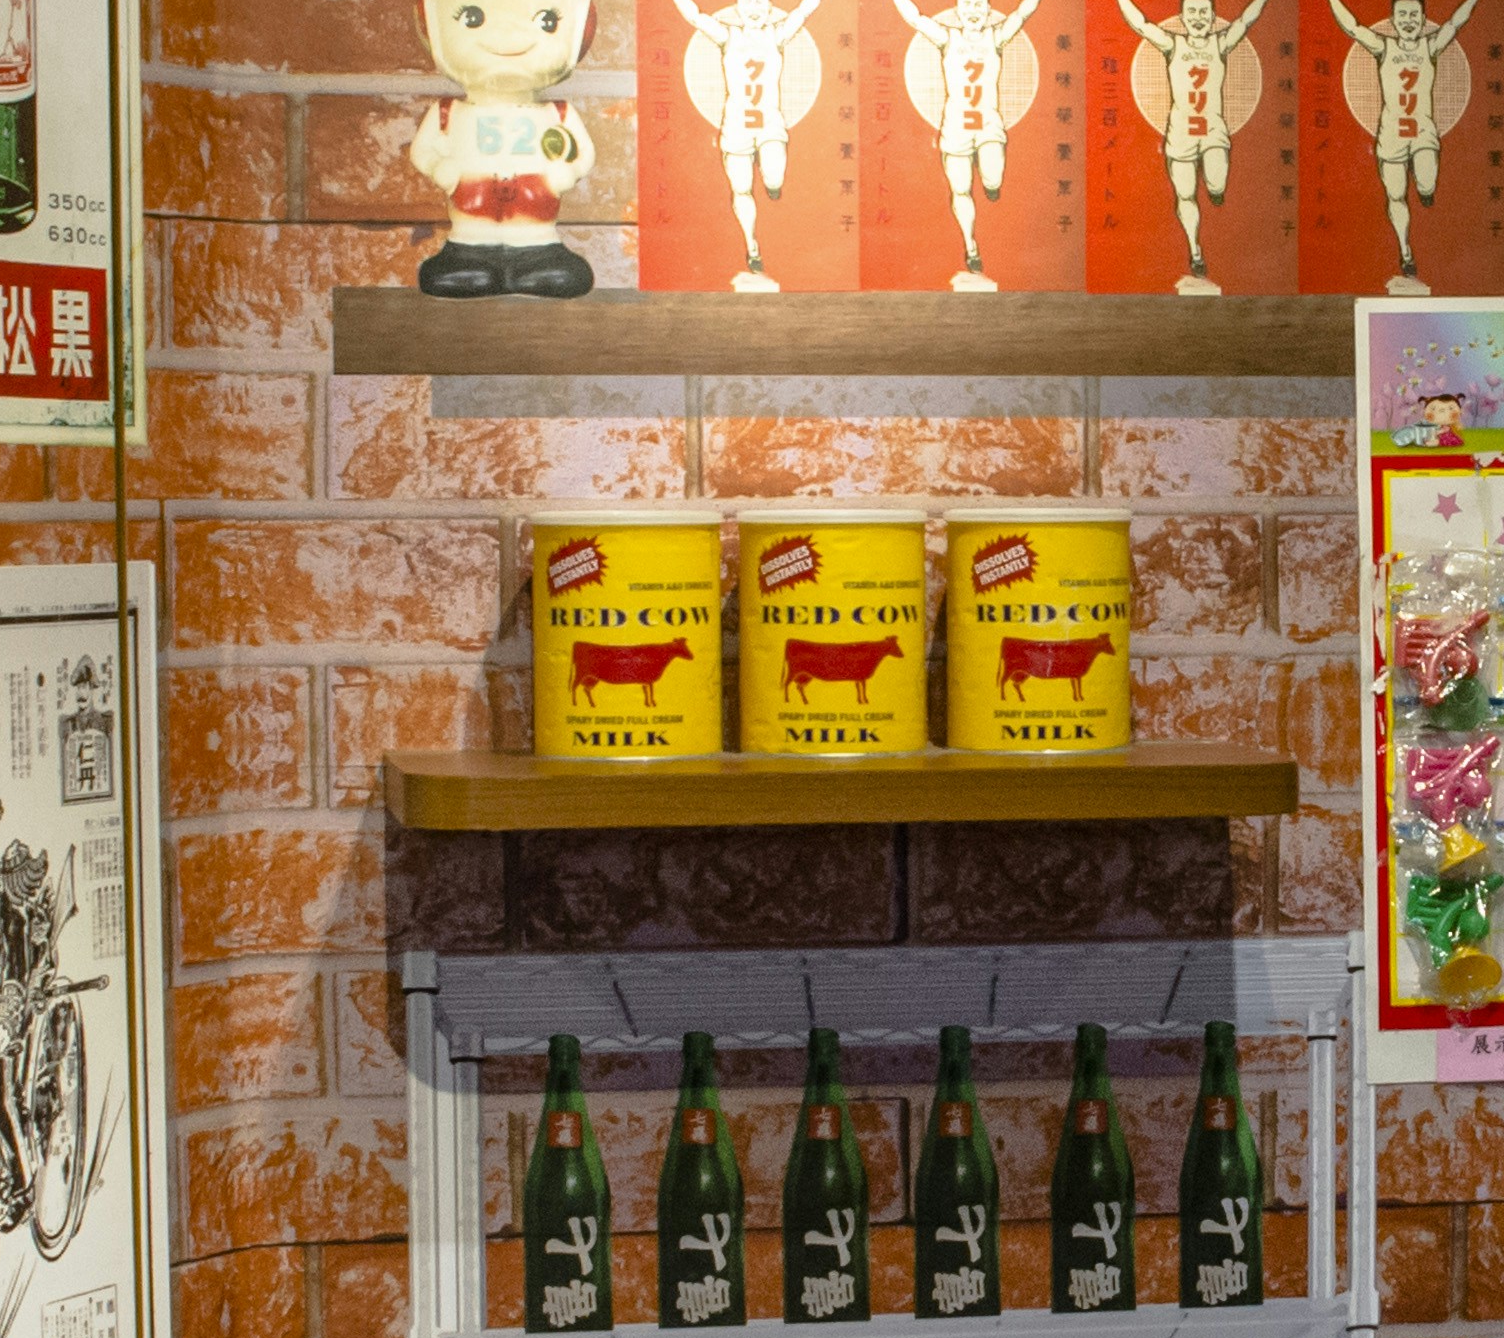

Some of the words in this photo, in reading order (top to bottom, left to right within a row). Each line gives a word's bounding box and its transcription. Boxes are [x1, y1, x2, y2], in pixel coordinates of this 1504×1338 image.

[1187, 62, 1210, 138] グリコ
[1397, 65, 1420, 140] グリコ
[475, 116, 537, 156] 52
[47, 192, 106, 216] 350cc
[47, 225, 108, 249] 630cc
[973, 543, 1027, 575] DISSOLVES
[978, 555, 1030, 587] INSTANTLY
[551, 607, 628, 627] RED
[638, 606, 710, 627] COW
[761, 605, 841, 625] RED
[851, 604, 918, 625] COW
[976, 604, 1057, 623] RED
[1068, 603, 1127, 623] COW
[626, 715, 649, 725] FULL
[652, 715, 684, 724] CREAM
[839, 712, 862, 722] FULL
[863, 712, 894, 722] CREAM
[1056, 710, 1079, 719] FULL
[1079, 709, 1107, 718] CREAM
[572, 731, 670, 747] MILK
[784, 728, 881, 743] MILK
[1001, 725, 1096, 741] MILK
[77, 742, 96, 792] 仁丹
